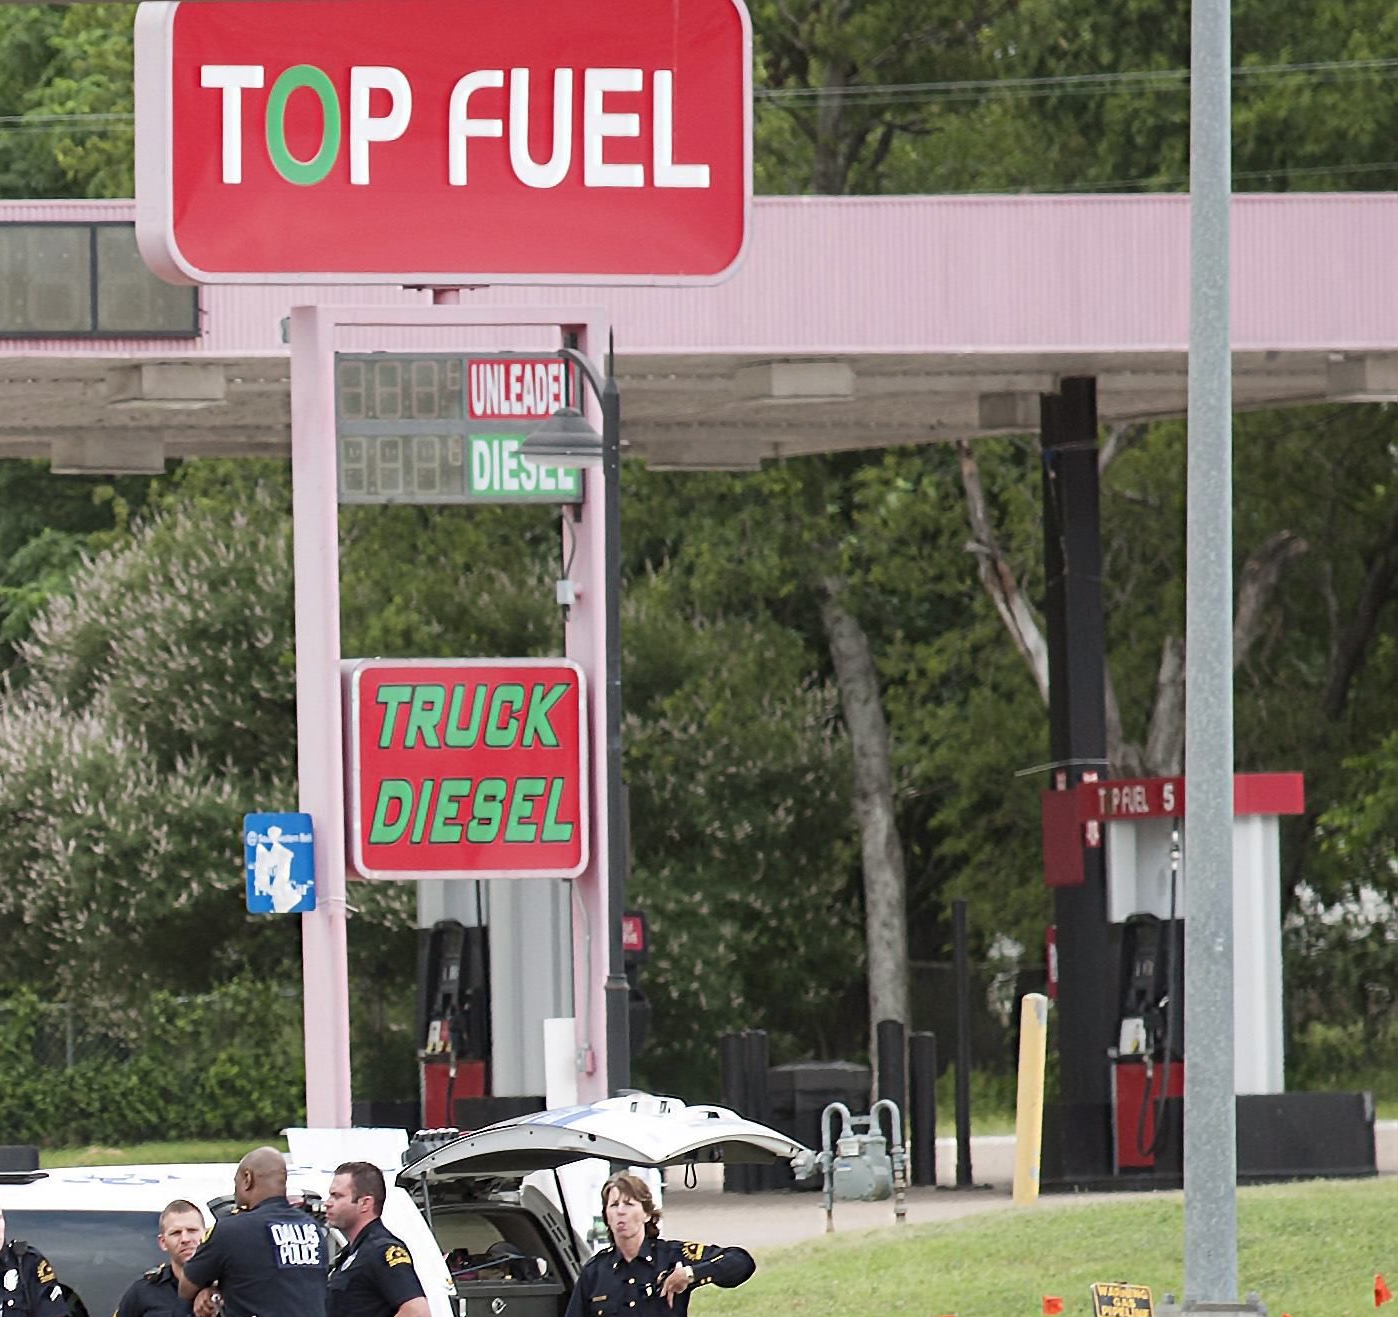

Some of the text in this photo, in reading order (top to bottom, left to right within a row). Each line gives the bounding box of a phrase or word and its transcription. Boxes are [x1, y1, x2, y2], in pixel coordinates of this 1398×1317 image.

[201, 64, 711, 189] TOP FUEL
[375, 683, 571, 750] TRUCK
[368, 777, 574, 845] DIESEL
[1163, 782, 1175, 812] 5
[271, 1223, 320, 1247] DALLAS
[280, 1244, 320, 1265] POLICE
[1113, 1297, 1137, 1308] GAS
